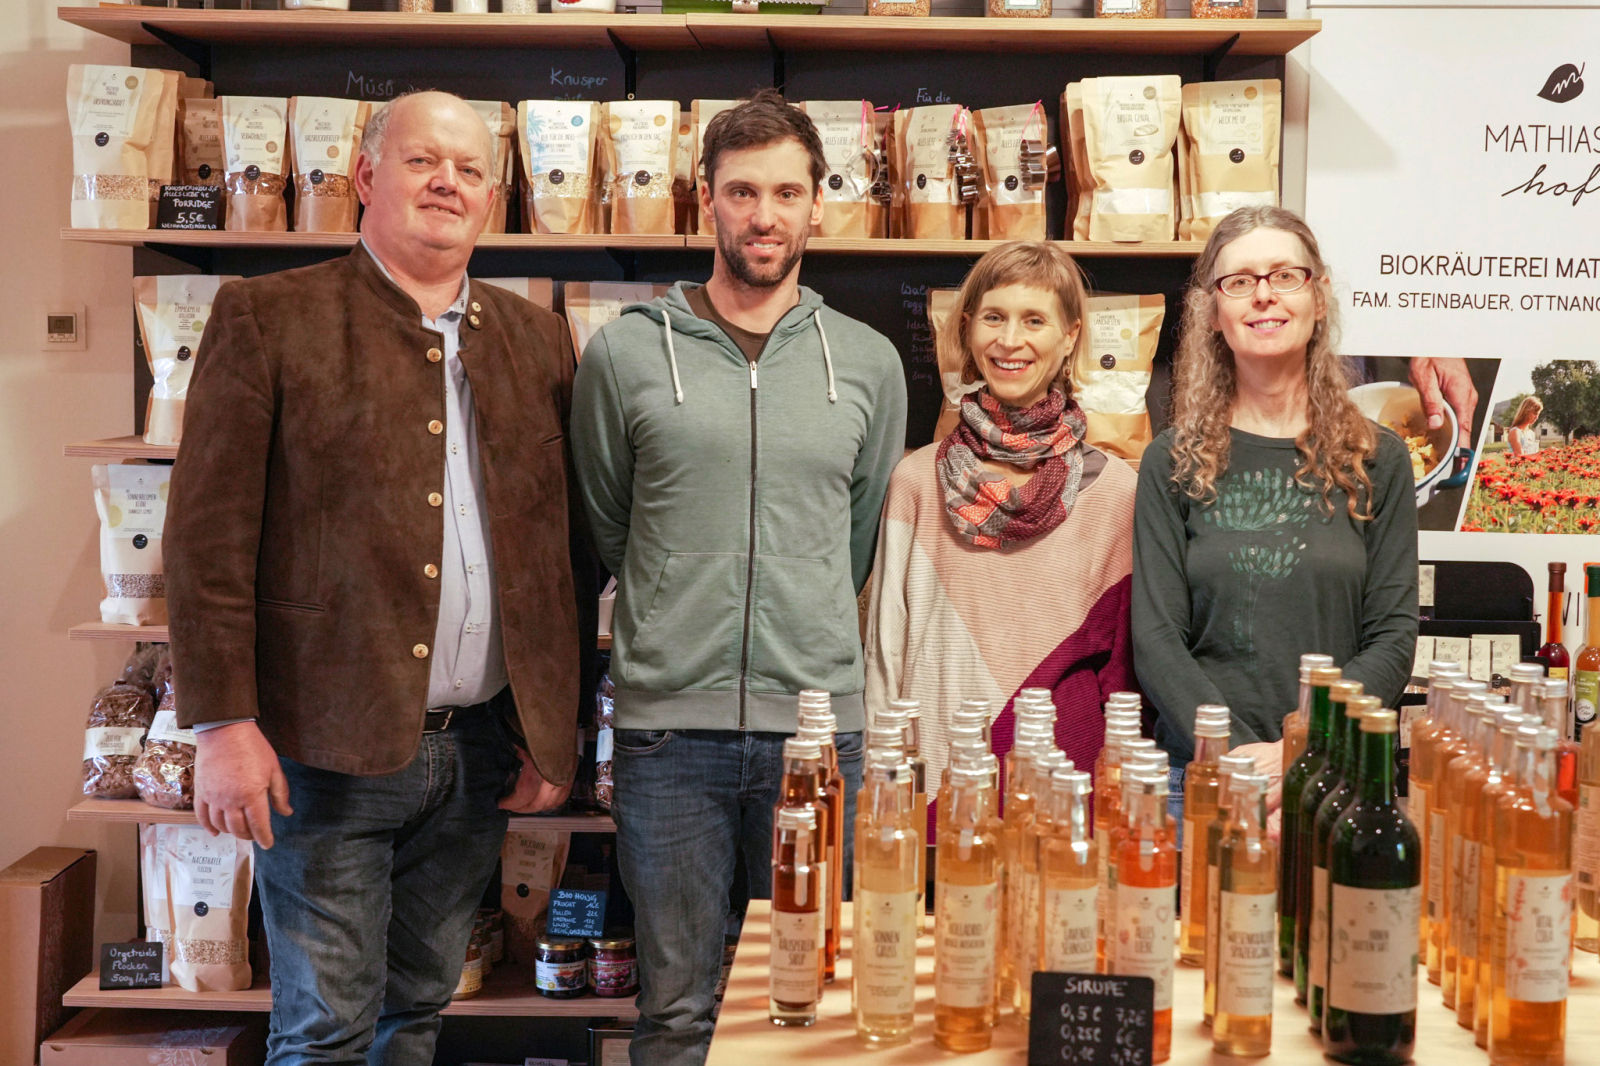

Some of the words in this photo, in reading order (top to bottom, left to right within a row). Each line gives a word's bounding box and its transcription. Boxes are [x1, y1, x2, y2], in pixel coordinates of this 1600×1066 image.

[549, 67, 608, 90] Knusper
[172, 198, 215, 209] PORRIDGE
[1380, 252, 1548, 278] BIOKRÄUTEREI
[1352, 292, 1392, 309] FAM.
[1064, 976, 1129, 997] SIRUPE
